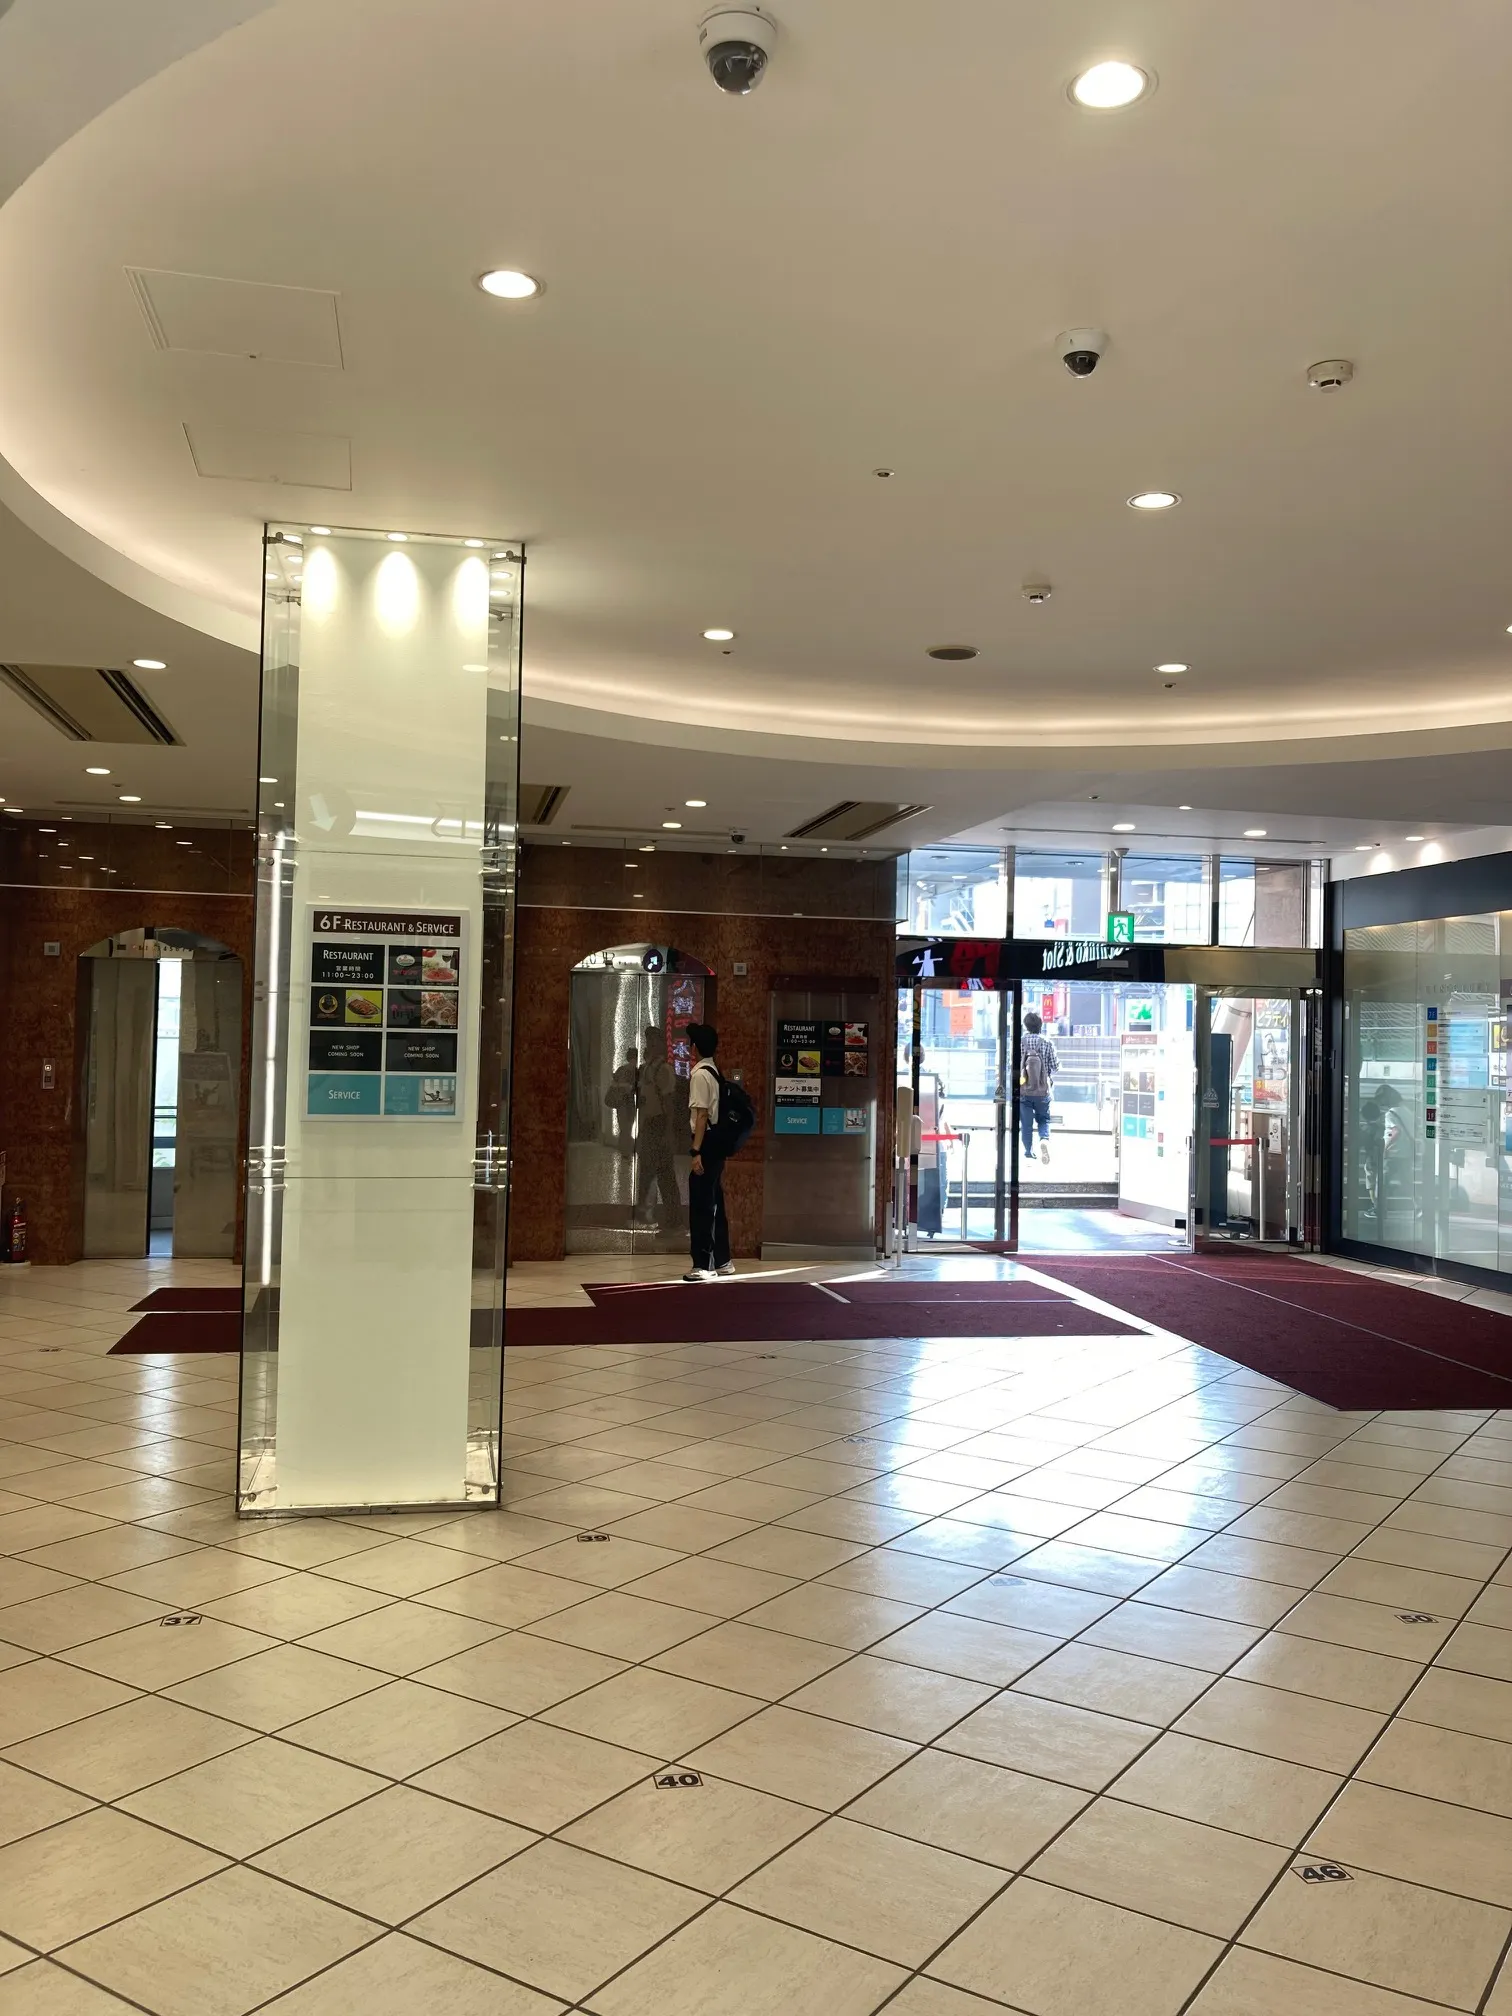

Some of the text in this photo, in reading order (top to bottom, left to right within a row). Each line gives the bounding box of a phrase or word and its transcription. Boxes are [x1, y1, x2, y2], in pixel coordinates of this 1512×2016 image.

[344, 918, 406, 932] RESTAURANT
[408, 924, 414, 932] &
[416, 921, 454, 934] SERVICE
[323, 950, 374, 961] RESTAURANT
[328, 1090, 361, 1100] SERVICE
[164, 1617, 199, 1625] 37
[658, 1775, 698, 1786] 40
[1302, 1866, 1346, 1880] 46
